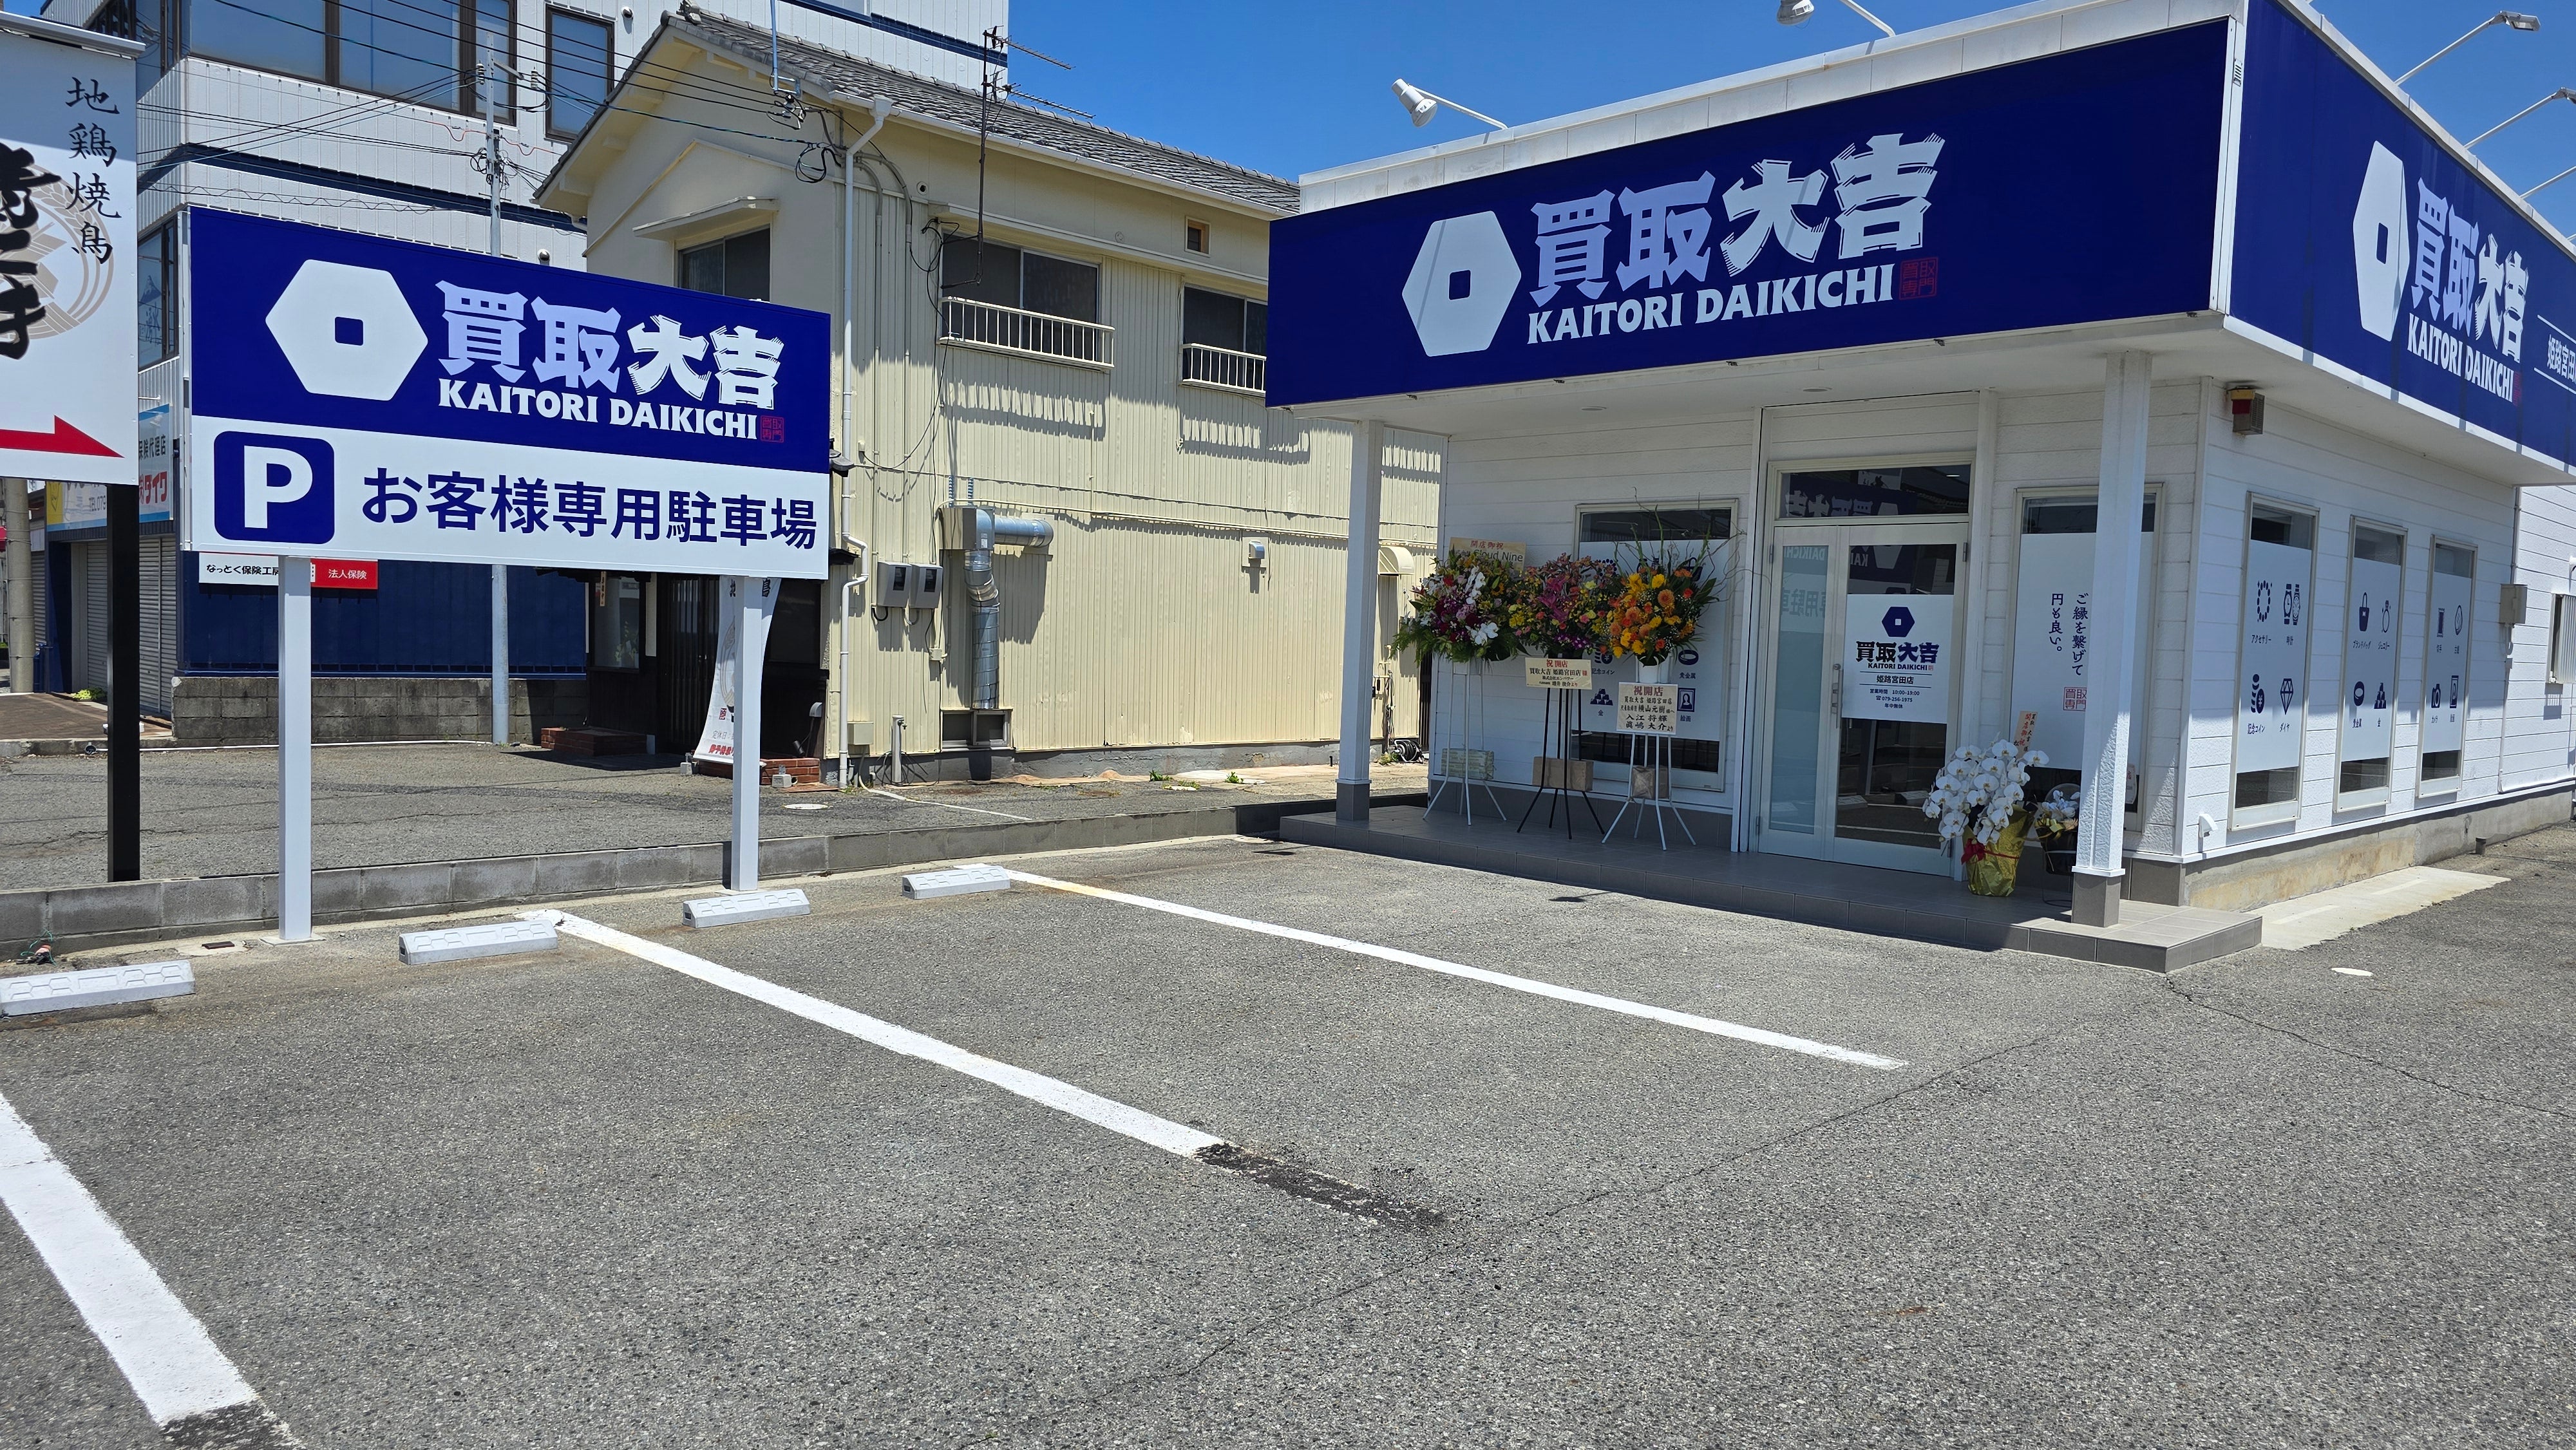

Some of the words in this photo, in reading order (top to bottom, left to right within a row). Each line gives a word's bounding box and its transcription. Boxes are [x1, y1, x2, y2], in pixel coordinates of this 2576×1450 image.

[66, 77, 122, 265] 地鶏焼鳥
[1530, 133, 1946, 307] 買取大吉
[1527, 290, 1681, 344] KAITORI
[1695, 263, 1896, 325] DAIKICHI
[2410, 177, 2529, 363] 買取大吉
[435, 280, 784, 410] 買取大吉
[2407, 312, 2462, 377] KAITORI
[2465, 345, 2515, 402] DAIKICHI
[438, 378, 598, 424] KAITORI
[609, 398, 758, 440] DAIKICHI
[244, 446, 313, 529] P
[363, 467, 817, 550] お客様専用駐車場
[328, 569, 367, 579] 法人保険
[1502, 552, 1523, 561] Nine
[1856, 641, 1940, 663] 買取大吉
[2072, 593, 2088, 675] ご縁を繋げて
[1877, 675, 1914, 684] 姫路宮田店
